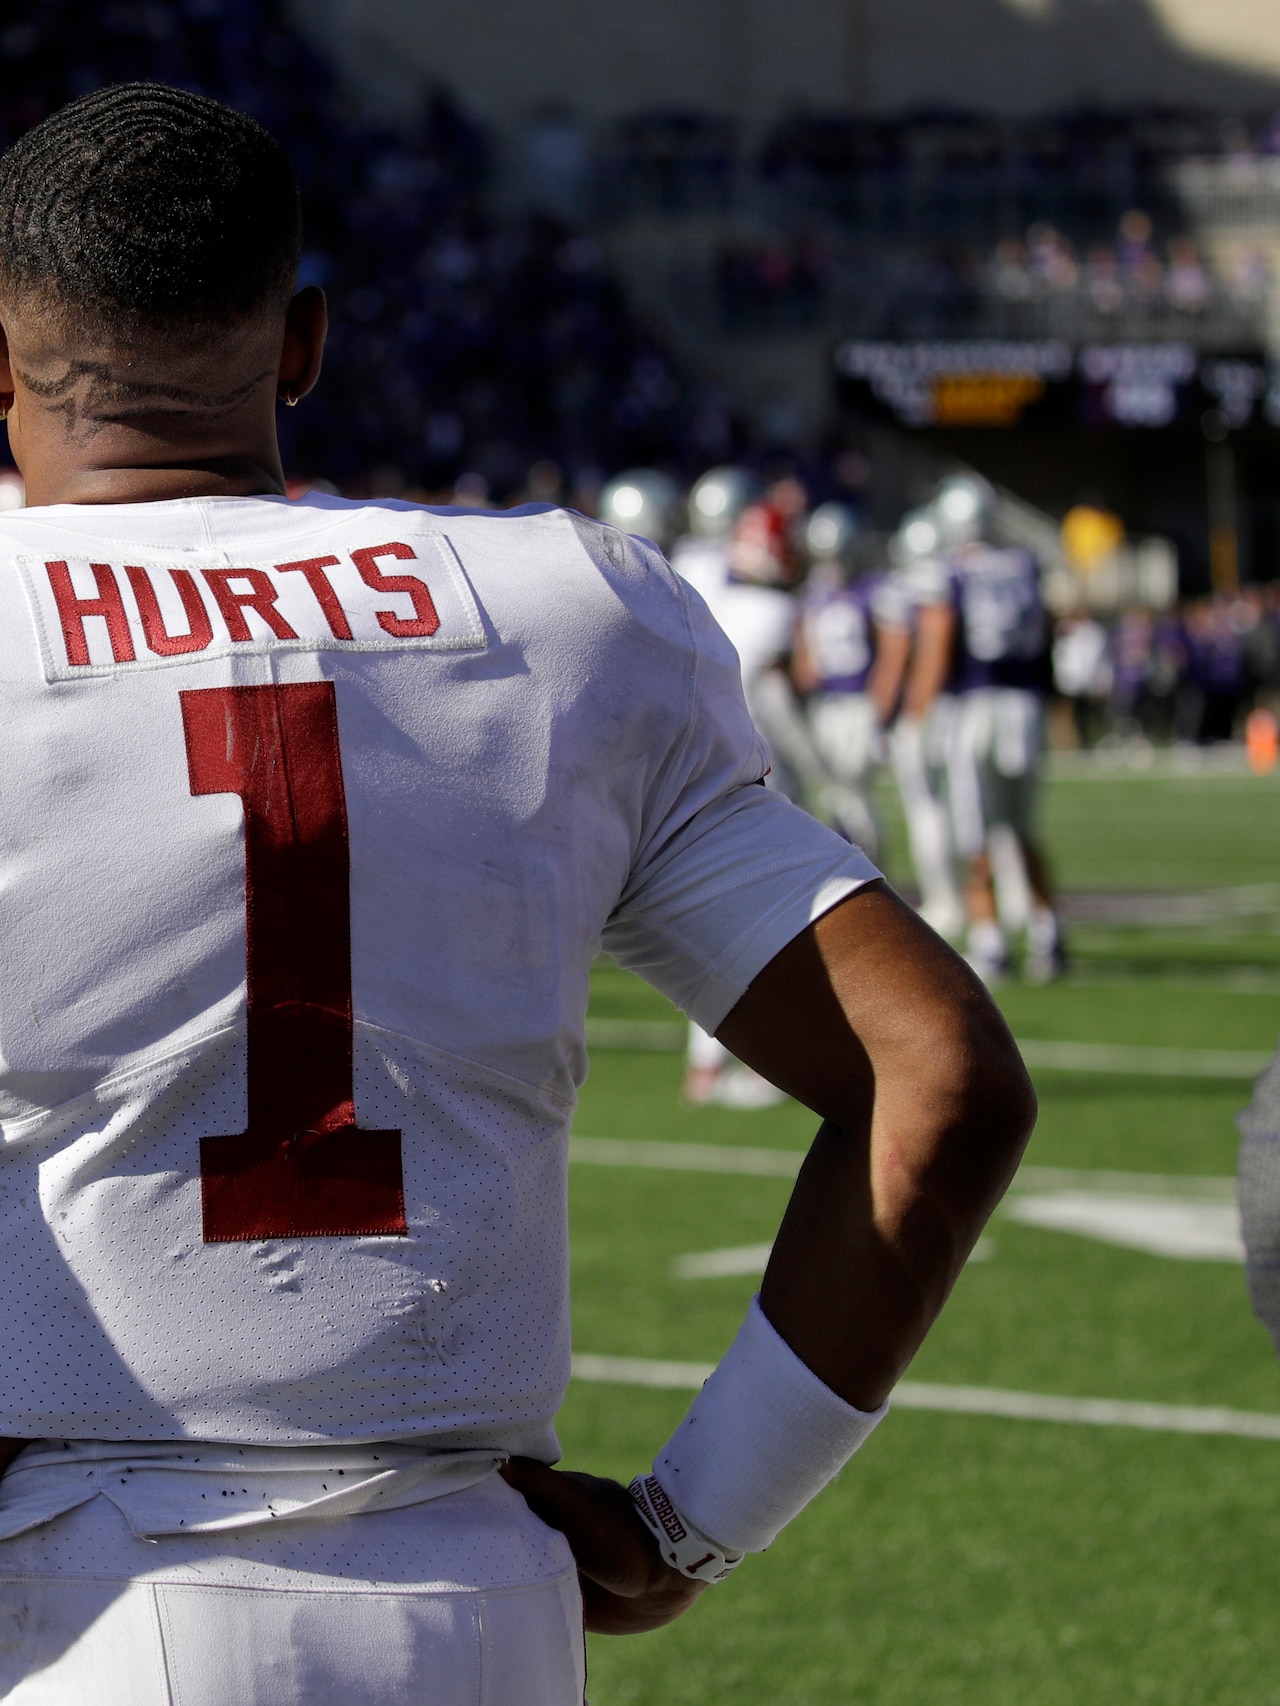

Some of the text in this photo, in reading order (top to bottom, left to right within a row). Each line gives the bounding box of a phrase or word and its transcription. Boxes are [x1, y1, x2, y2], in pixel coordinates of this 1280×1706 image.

[44, 541, 442, 666] HURTS
[178, 680, 408, 1243] 1
[686, 1552, 716, 1575] 1
